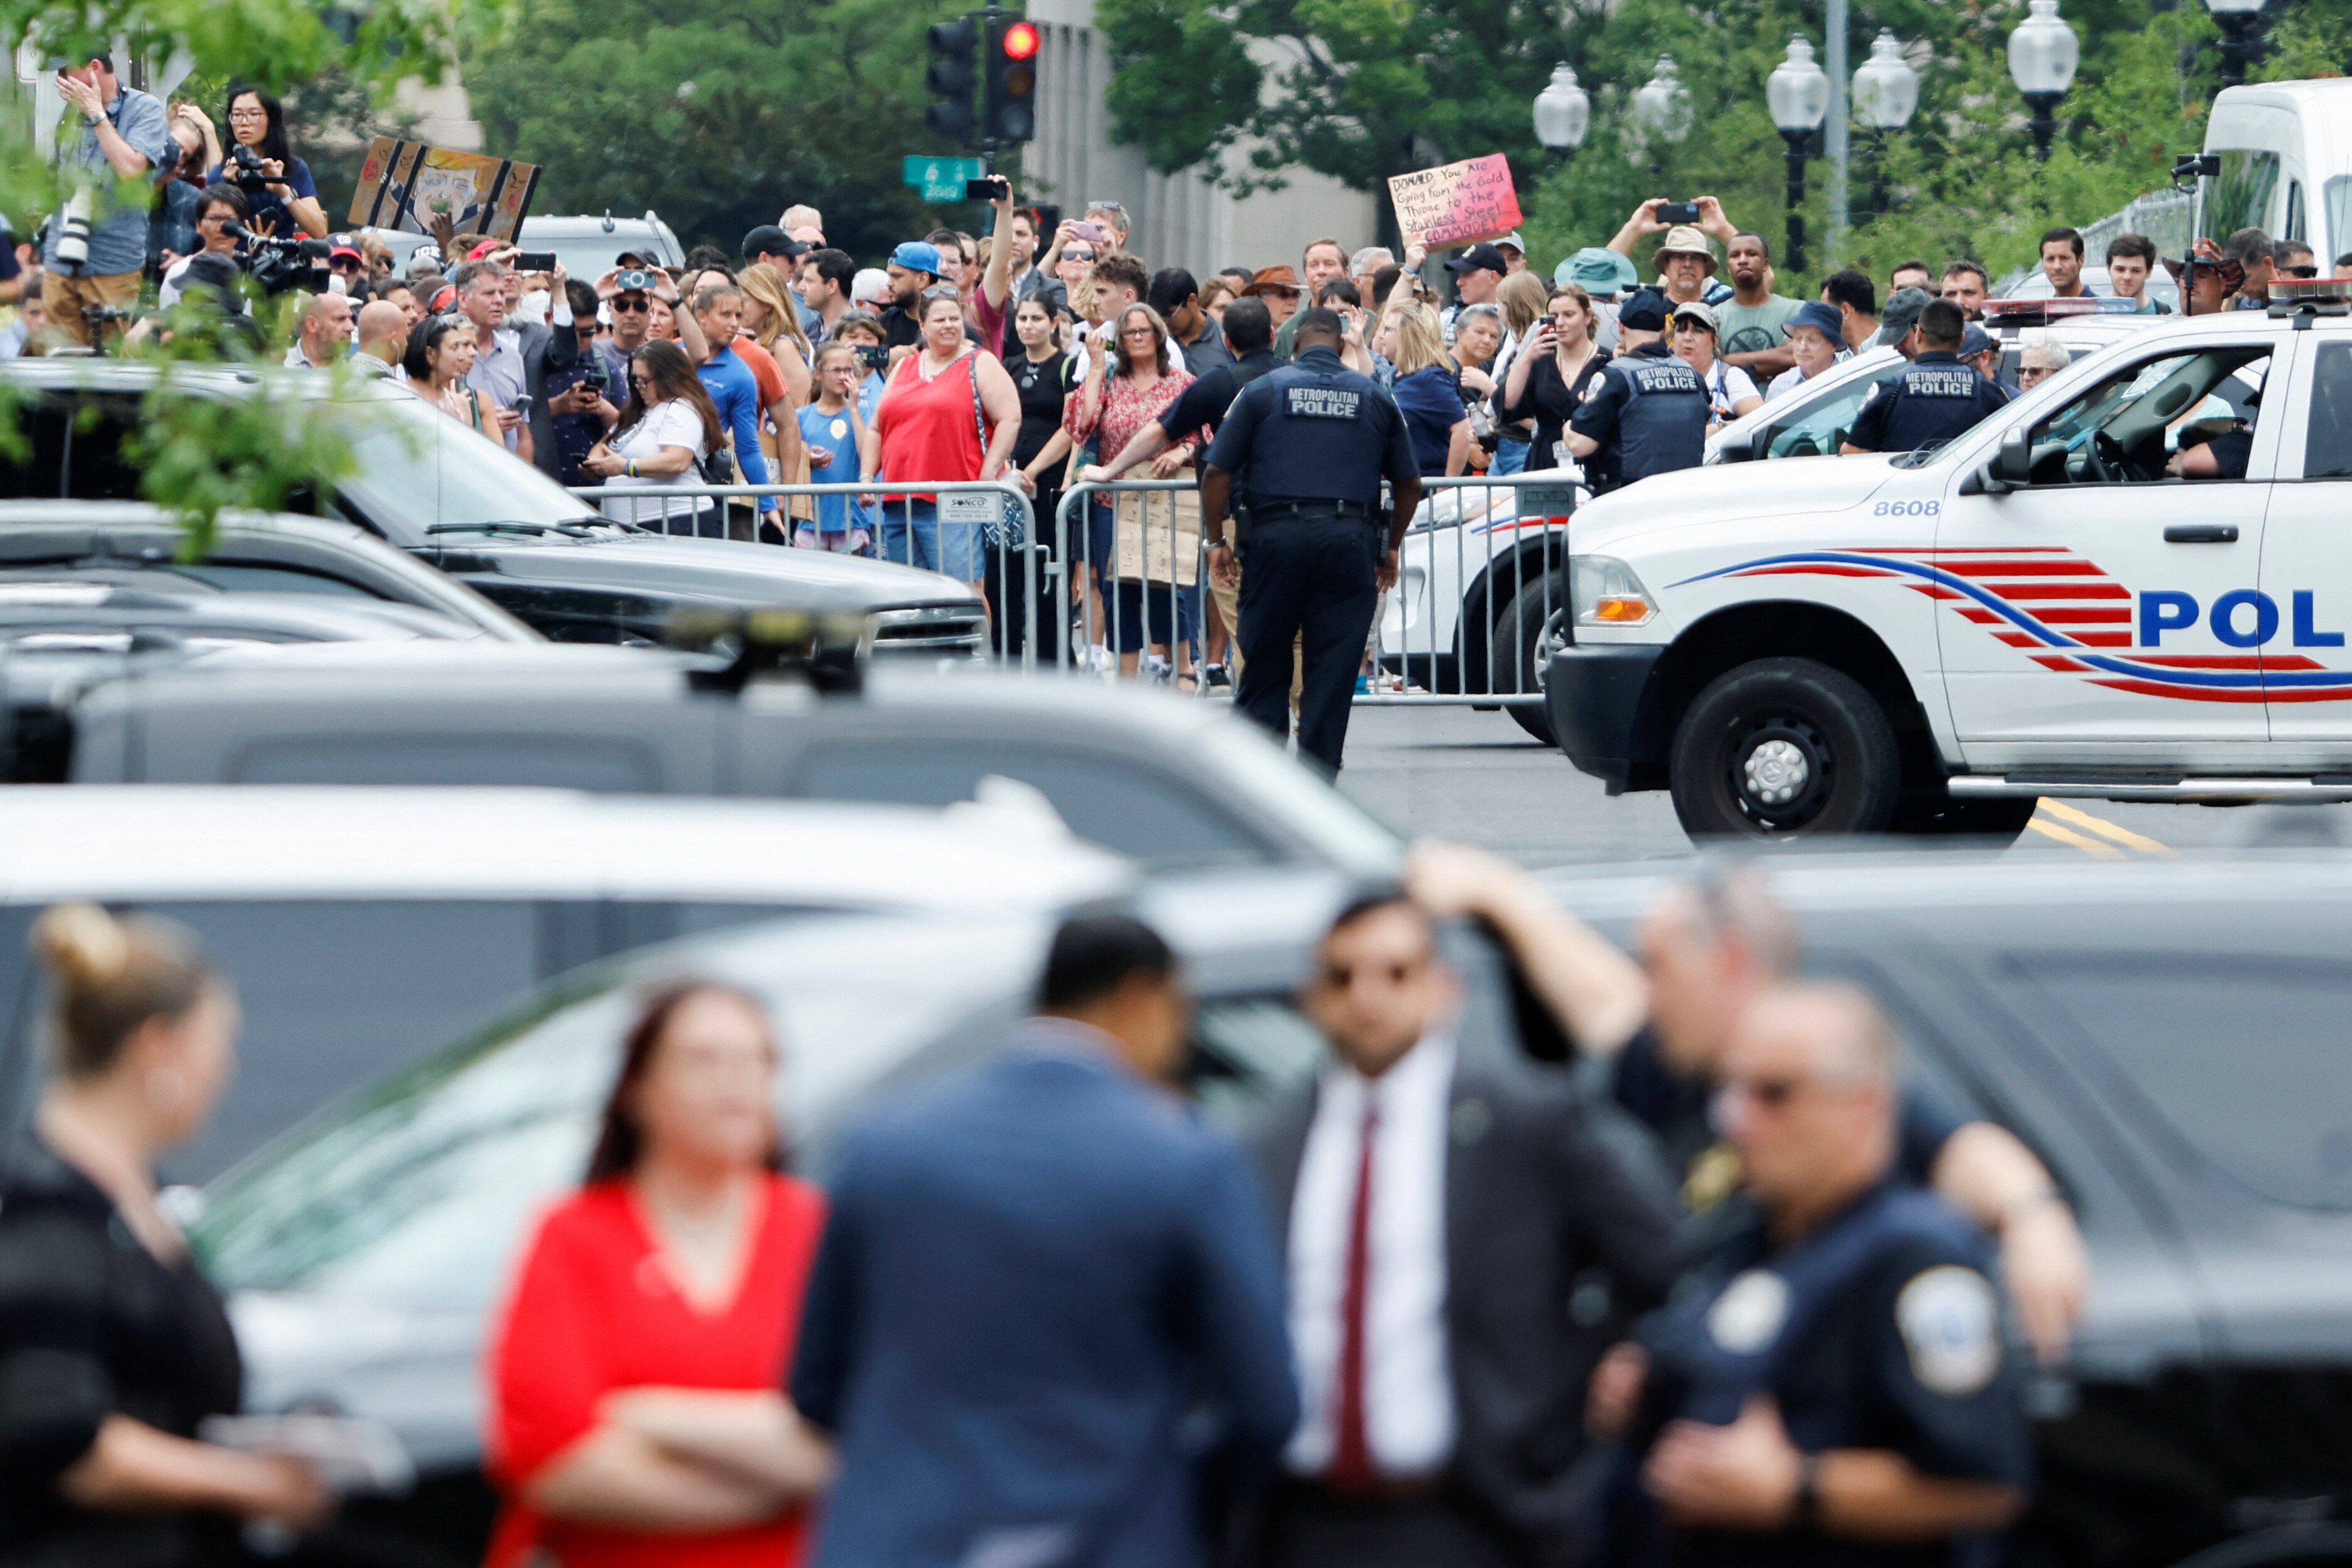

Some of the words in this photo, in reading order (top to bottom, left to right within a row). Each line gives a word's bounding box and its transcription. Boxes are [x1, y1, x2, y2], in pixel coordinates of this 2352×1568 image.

[1393, 172, 1434, 192] DONALD
[1440, 167, 1461, 180] You
[1467, 161, 1488, 173] Are
[1397, 192, 1425, 204] Going
[1455, 180, 1473, 192] the
[1478, 170, 1505, 187] Gold
[1403, 204, 1440, 218] Throne
[1447, 197, 1461, 208] to
[1471, 190, 1494, 204] the
[1405, 214, 1456, 232] Stainless
[1464, 202, 1501, 219] Steel
[1636, 366, 1695, 381] METROPOLITAN
[1905, 371, 1973, 384] METROPOLITAN
[1642, 378, 1697, 391] POLICE
[1908, 381, 1973, 396] POLICE
[1288, 388, 1359, 405] METROPOLITAN
[1292, 400, 1356, 416] POLICE
[1873, 500, 1940, 516] 8608
[2139, 588, 2346, 648] POL
